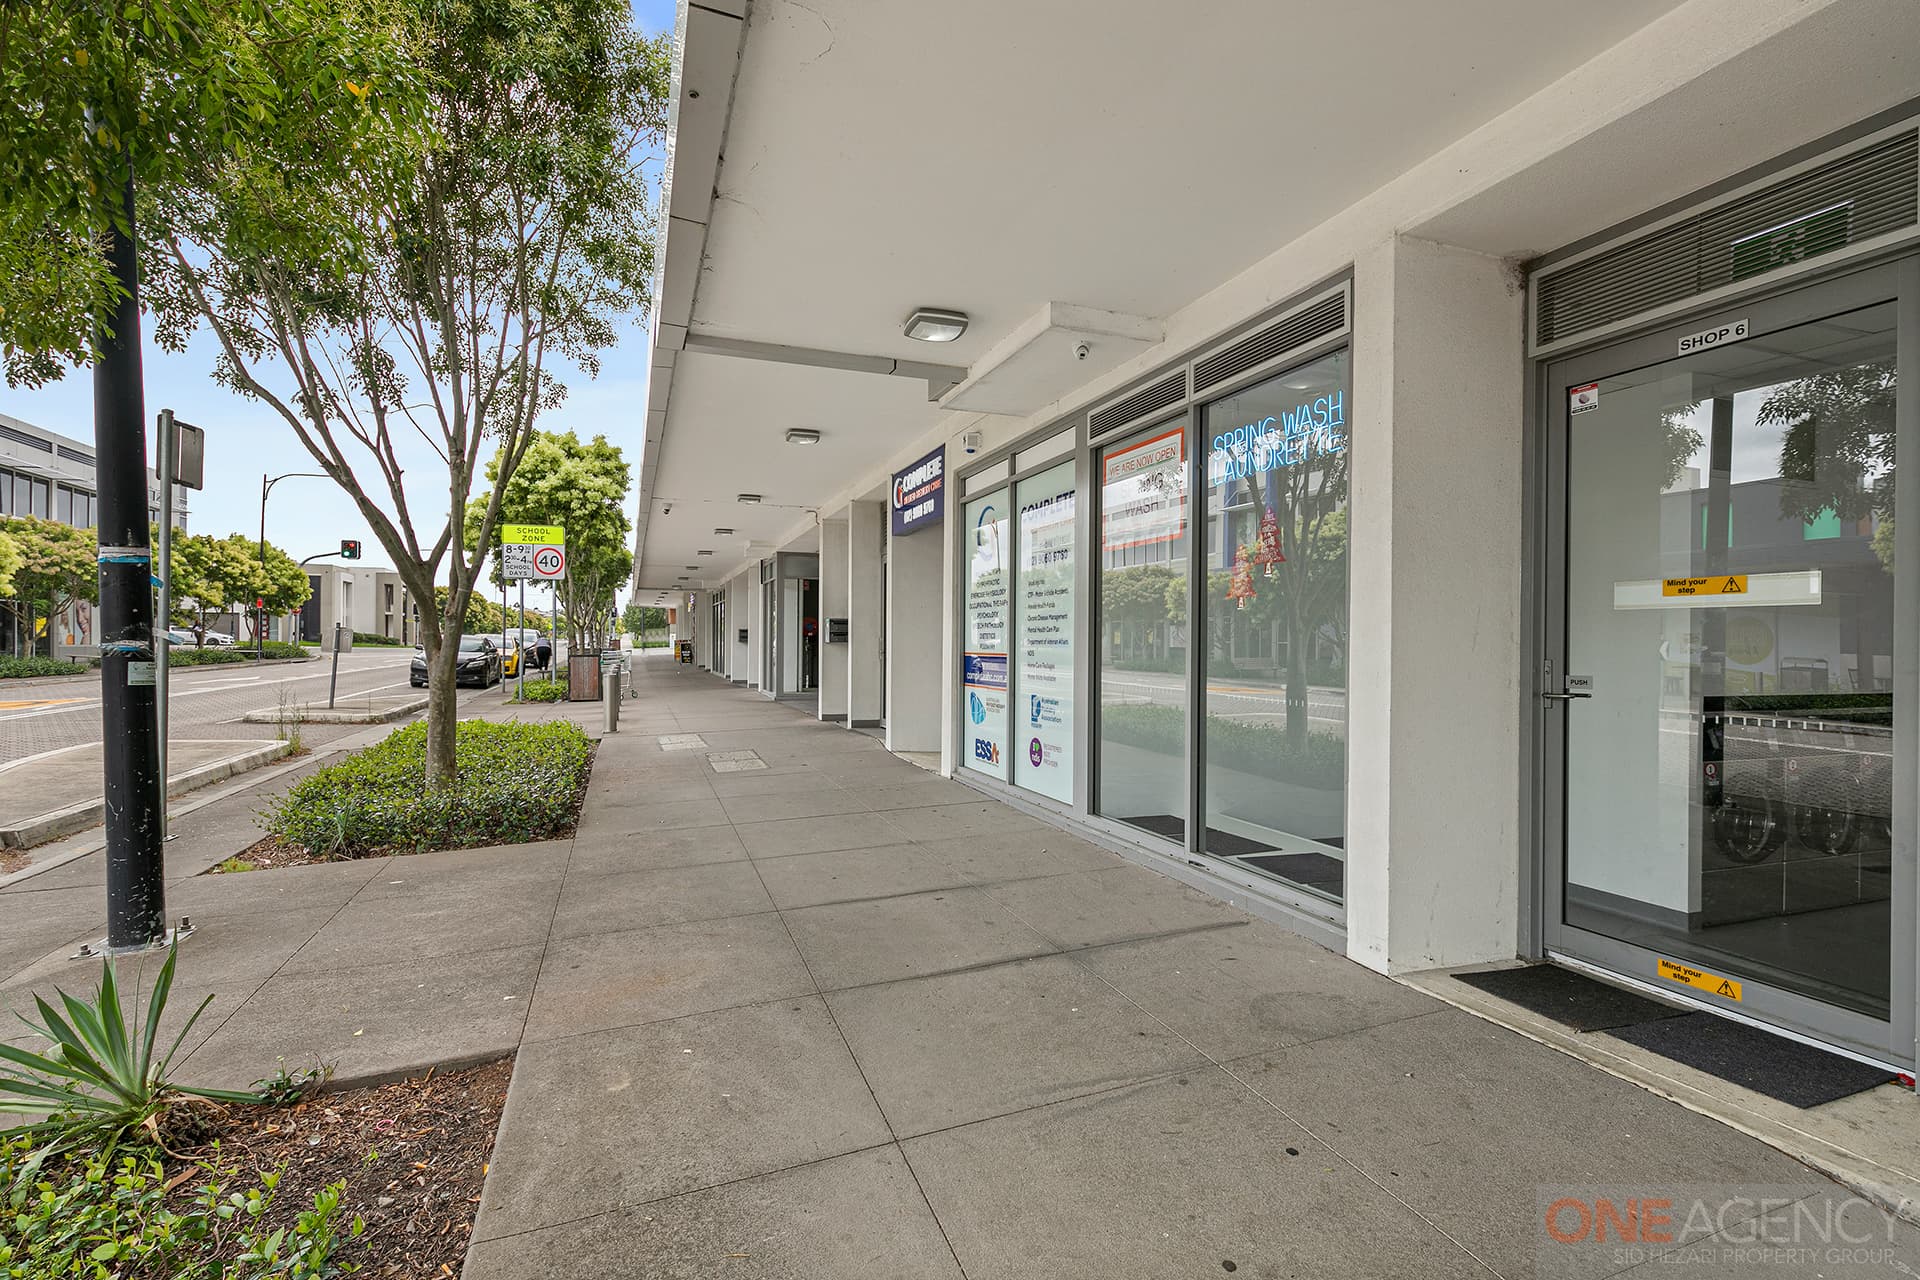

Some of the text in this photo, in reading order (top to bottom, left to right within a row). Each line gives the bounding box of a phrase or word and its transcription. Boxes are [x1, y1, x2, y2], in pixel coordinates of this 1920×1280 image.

[1680, 324, 1745, 351] SHOP 6
[1213, 390, 1345, 461] SPRING WASH
[1109, 446, 1177, 476] WE ARE NOW OPEN
[1213, 421, 1345, 486] LAUNDRETTE
[516, 527, 551, 535] SCHOOL
[538, 555, 560, 568] 40
[1666, 579, 1708, 587] Mind your
[1661, 960, 1703, 978] Mind your
[1672, 972, 1691, 984] step
